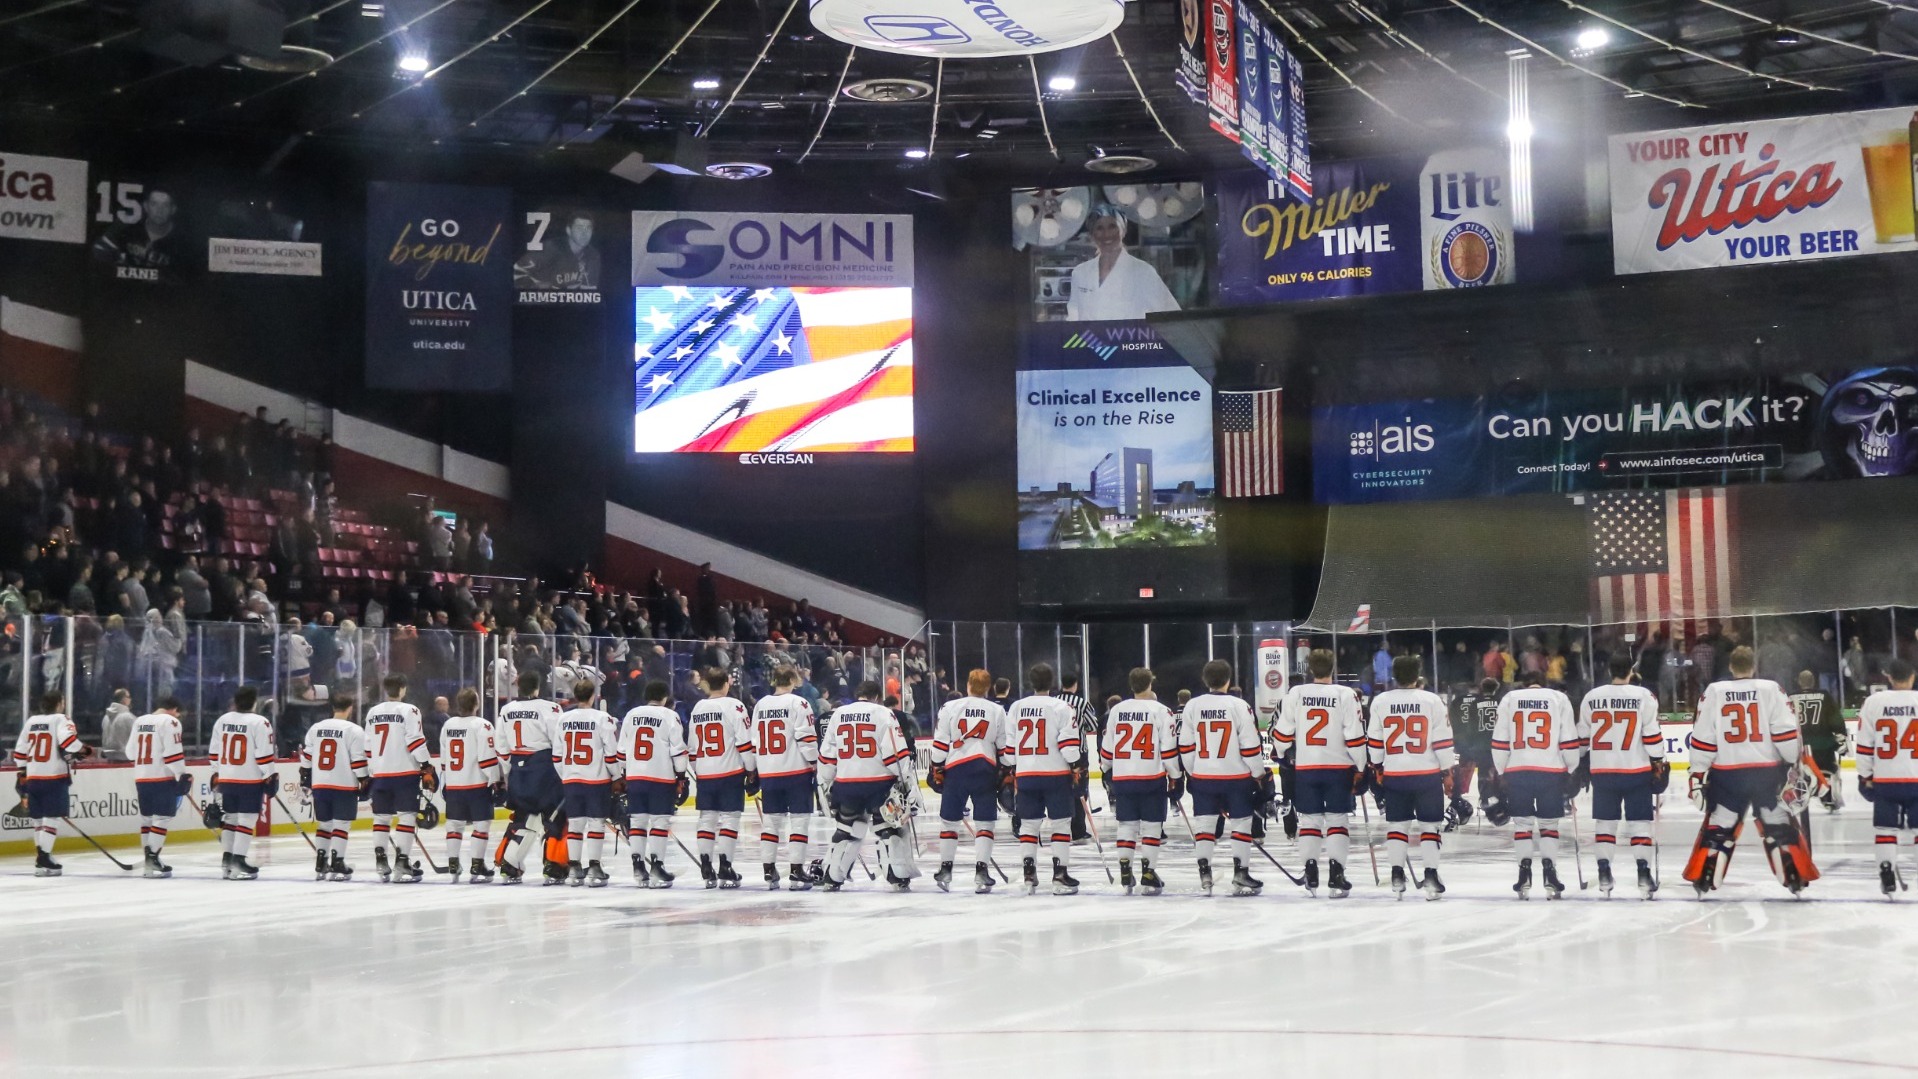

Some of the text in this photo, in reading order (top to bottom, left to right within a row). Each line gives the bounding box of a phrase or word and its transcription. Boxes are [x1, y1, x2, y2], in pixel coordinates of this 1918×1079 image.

[964, 0, 1050, 47] HOND
[1626, 132, 1748, 163] YOUR CITY
[96, 181, 143, 224] 15
[1431, 171, 1502, 221] Lite
[1648, 143, 1843, 251] Utica
[420, 218, 460, 237] GO
[527, 212, 551, 251] 7
[1242, 182, 1391, 260] Miller
[728, 220, 894, 262] OMNI
[1445, 226, 1463, 245] FINE
[1465, 223, 1495, 251] PILSNER
[1725, 230, 1859, 260] YOUR BEER
[234, 246, 270, 256] BROCK
[272, 248, 318, 258] AGENCY
[389, 223, 502, 281] beyond
[116, 266, 159, 280] KANE
[729, 263, 894, 272] PAIN AND PRECISION MEDICINE
[1268, 266, 1372, 285] ONLY 96 CALORIES
[402, 290, 477, 311] UTICA
[519, 291, 602, 303] ARMSTRONG
[410, 319, 471, 327] UNIVERSITY
[413, 340, 465, 350] utica.edu
[1121, 343, 1163, 351] HOSPITAL
[1027, 387, 1201, 406] Clinical Excellence
[1054, 409, 1175, 427] is on the Rise
[1488, 414, 1551, 439] Can
[1562, 412, 1623, 441] you
[1632, 397, 1755, 433] HACK
[1381, 416, 1435, 453] ais
[750, 453, 814, 465] EVERSAN
[1517, 463, 1590, 474] Connect Today!
[1620, 452, 1765, 469] www.ainfosec.com/utica
[1353, 469, 1432, 479] CYBERSECURITY
[1361, 478, 1424, 488] INNOVATORS
[1302, 697, 1336, 707] SCOVILLE
[1390, 704, 1421, 714] HAVIAR
[1518, 700, 1548, 709] HUGHES
[1725, 691, 1757, 701] STURTZ
[632, 717, 662, 728] EVTIMOV
[693, 712, 723, 723] BRIGHTON
[840, 713, 871, 723] ROBERTS
[965, 708, 986, 718] BARR
[1021, 708, 1043, 717] VITALE
[1118, 712, 1149, 722] BREAULT
[1200, 710, 1227, 719] MORSE
[1721, 703, 1763, 743] 31
[1882, 706, 1916, 716] ACOSTA
[316, 729, 343, 738] HERRERA
[374, 723, 389, 757] 7
[446, 729, 467, 738] MURPHY
[513, 720, 527, 749] 1
[695, 722, 725, 758] 19
[757, 719, 786, 755] 16
[836, 723, 877, 759] 35
[1018, 719, 1049, 756] 21
[1115, 723, 1155, 759] 24
[1197, 721, 1232, 759] 17
[1306, 709, 1329, 746] 2
[1384, 715, 1428, 754] 29
[1513, 711, 1551, 750] 13
[1591, 711, 1637, 750] 27
[1876, 718, 1918, 759] 34
[137, 734, 153, 765] 11
[220, 733, 247, 765] 10
[318, 738, 337, 771] 8
[450, 739, 465, 771] 9
[564, 731, 593, 765] 15
[634, 727, 655, 761] 6
[68, 792, 140, 819] Excellus
